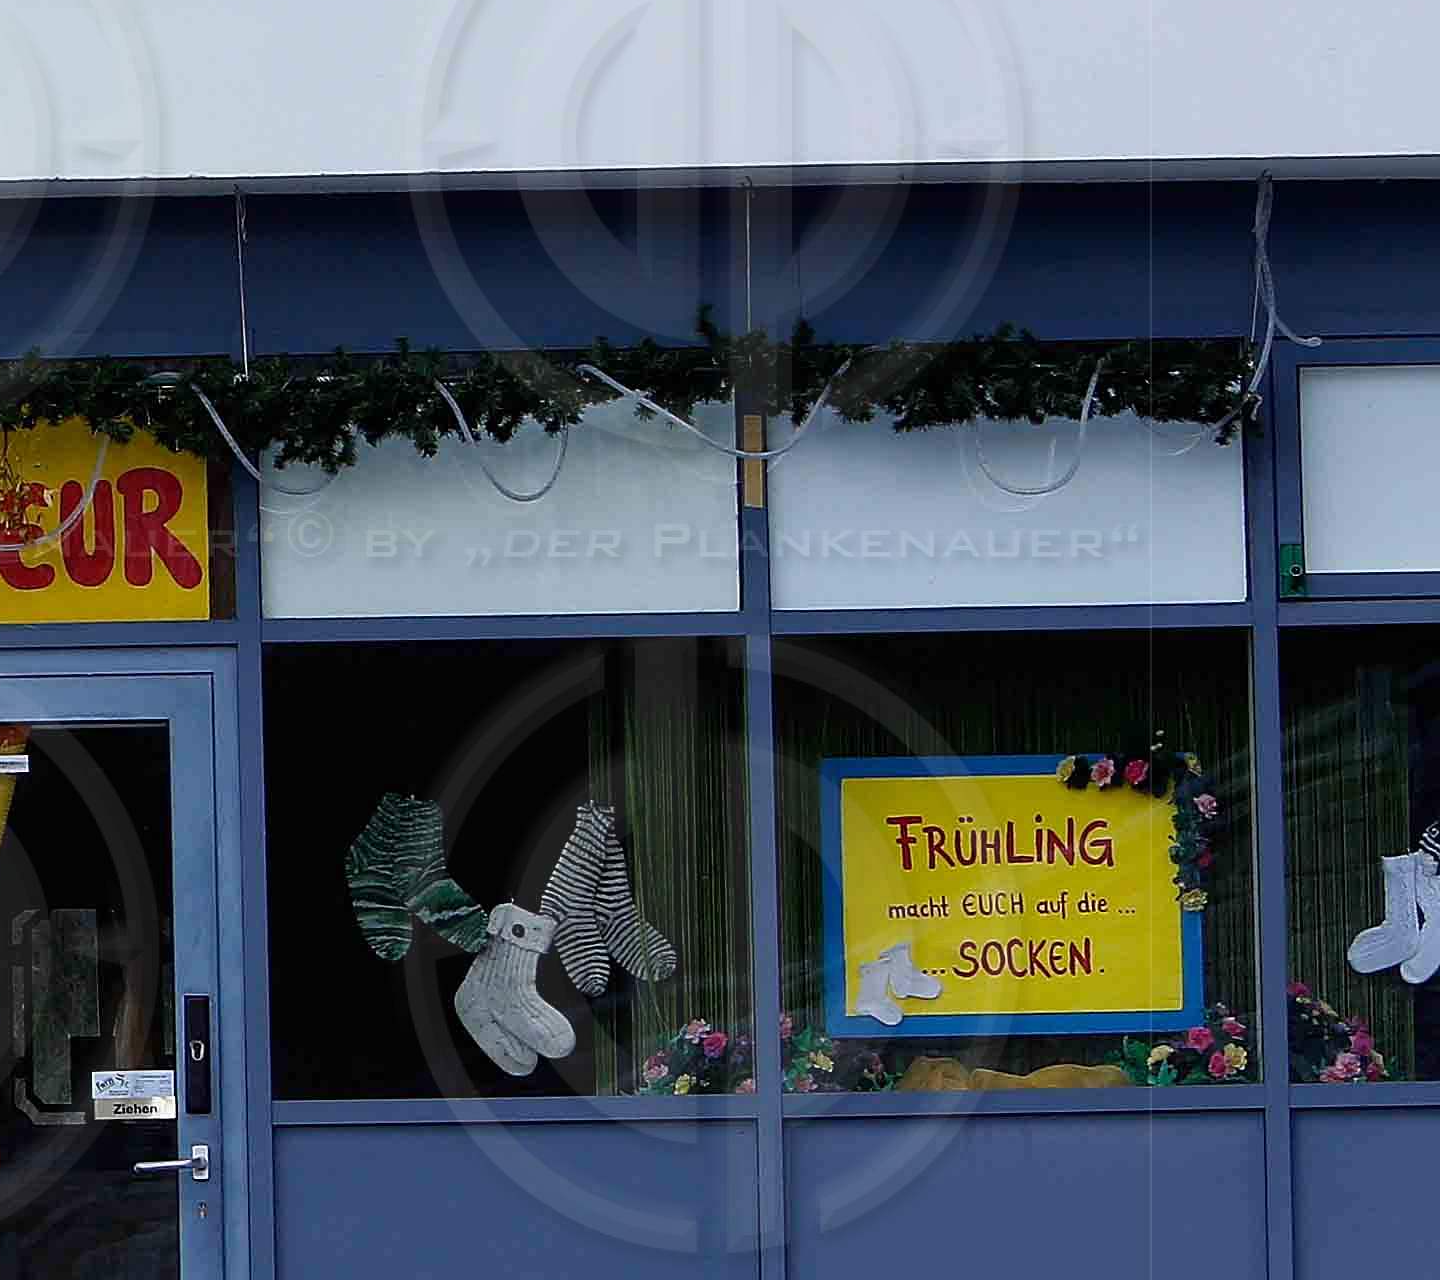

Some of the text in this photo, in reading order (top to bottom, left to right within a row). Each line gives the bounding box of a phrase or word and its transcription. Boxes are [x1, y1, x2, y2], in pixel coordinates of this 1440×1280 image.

[888, 895, 949, 920] macht
[962, 893, 1024, 916] EUCH
[1036, 892, 1068, 920] auf
[1078, 892, 1109, 915] die
[113, 1103, 158, 1114] Ziehen
